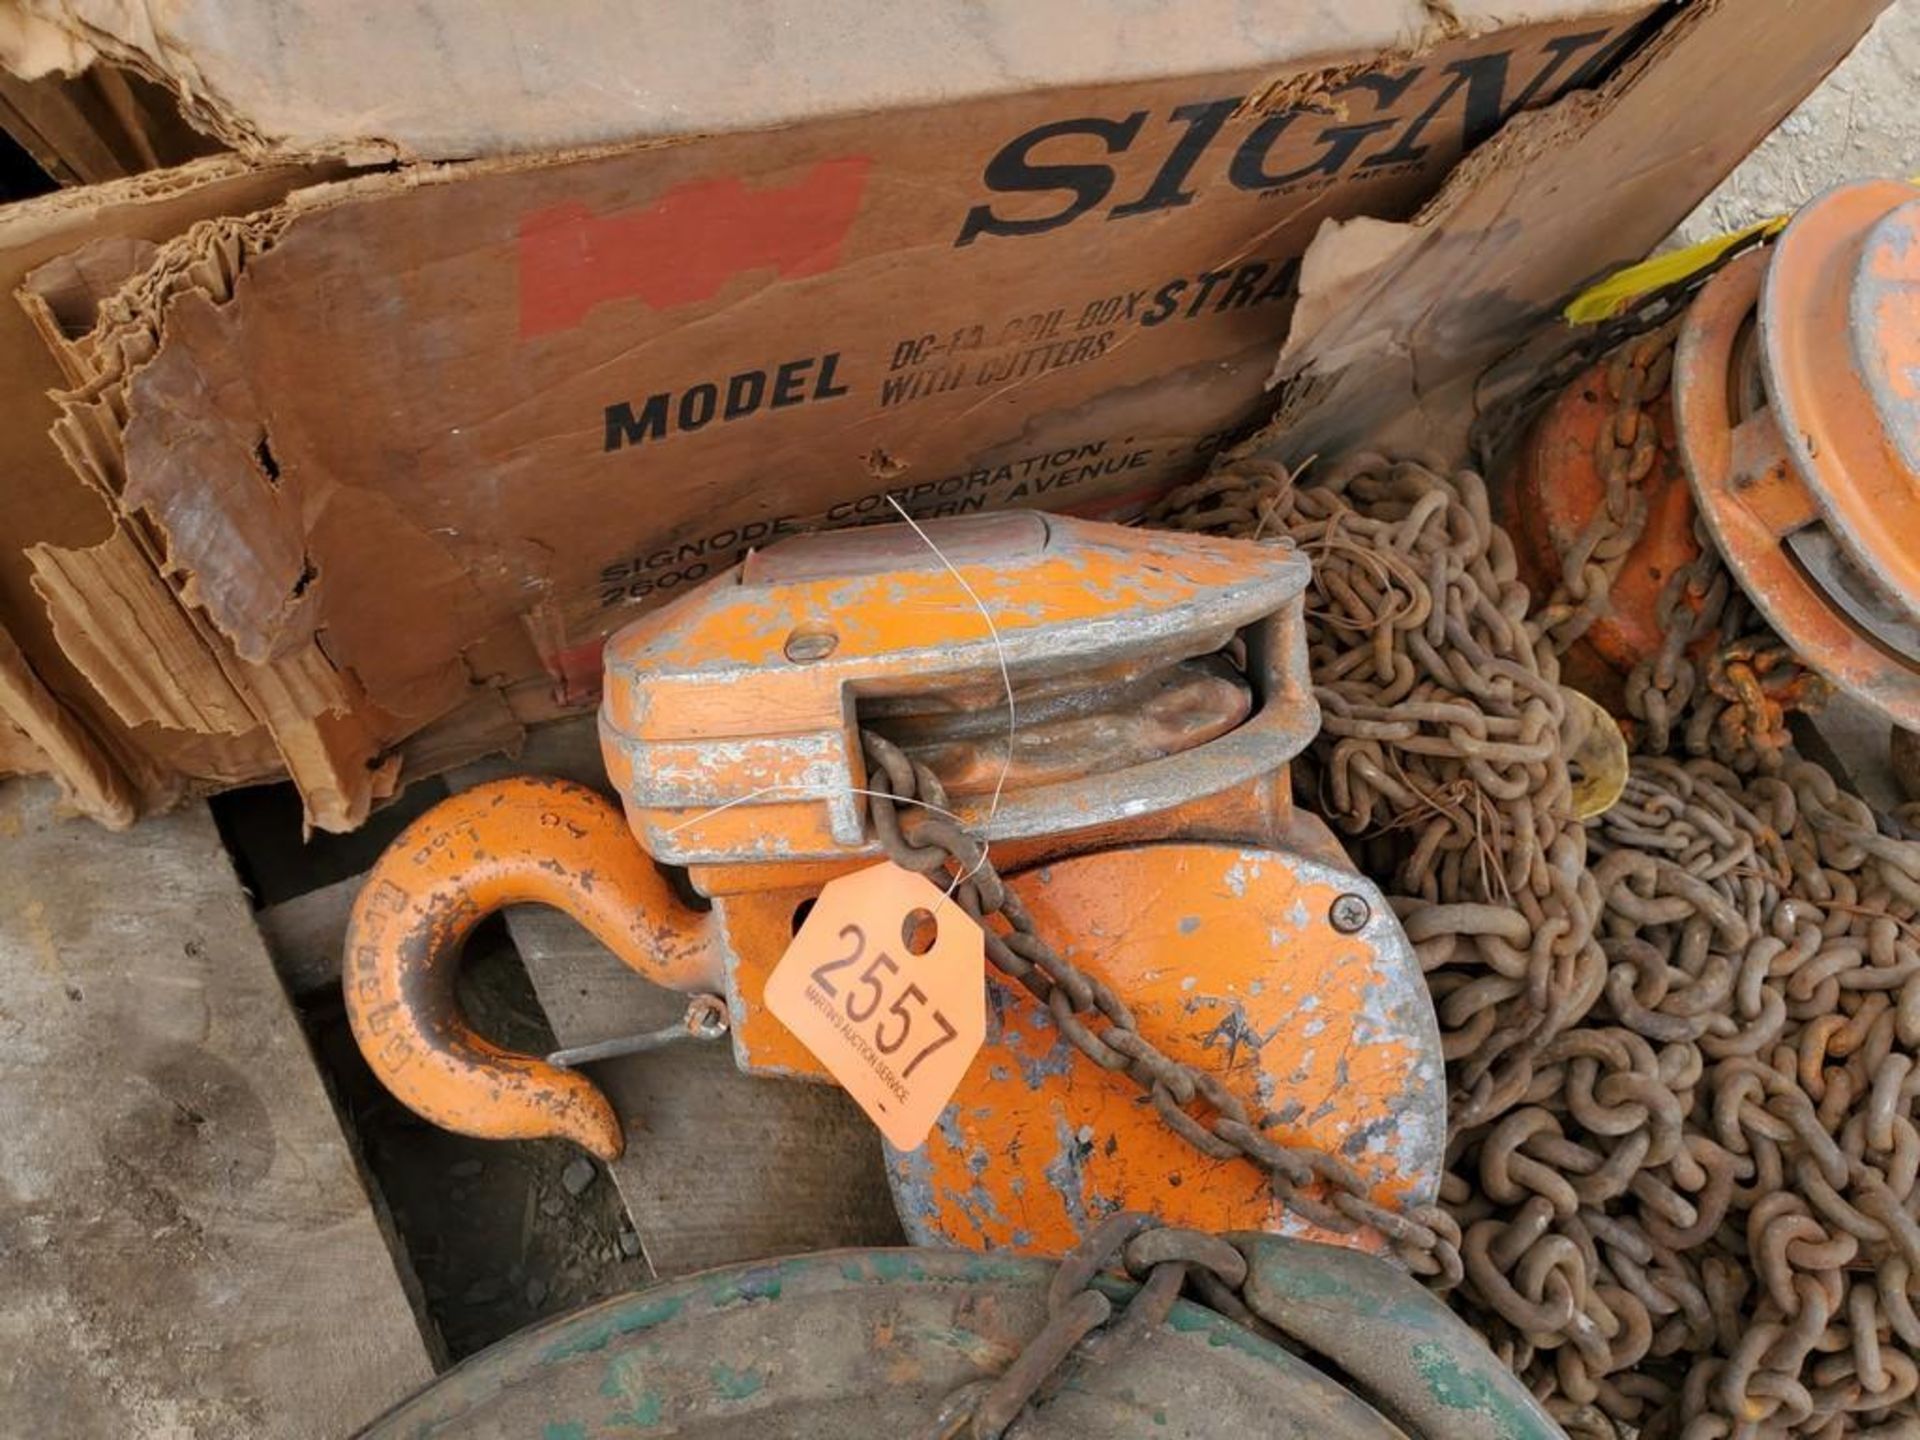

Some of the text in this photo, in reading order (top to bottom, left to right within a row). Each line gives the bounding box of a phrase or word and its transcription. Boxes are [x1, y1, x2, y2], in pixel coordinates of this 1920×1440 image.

[955, 27, 1622, 247] SIGN
[603, 352, 848, 452] MODEL
[600, 441, 1107, 583] SIGNODE CORPORATION
[602, 563, 709, 607] 2600
[1005, 449, 1152, 503] AVENUE
[810, 922, 958, 1079] 2557
[839, 1022, 880, 1073] AUCTION
[874, 1060, 911, 1105] SERVICE
